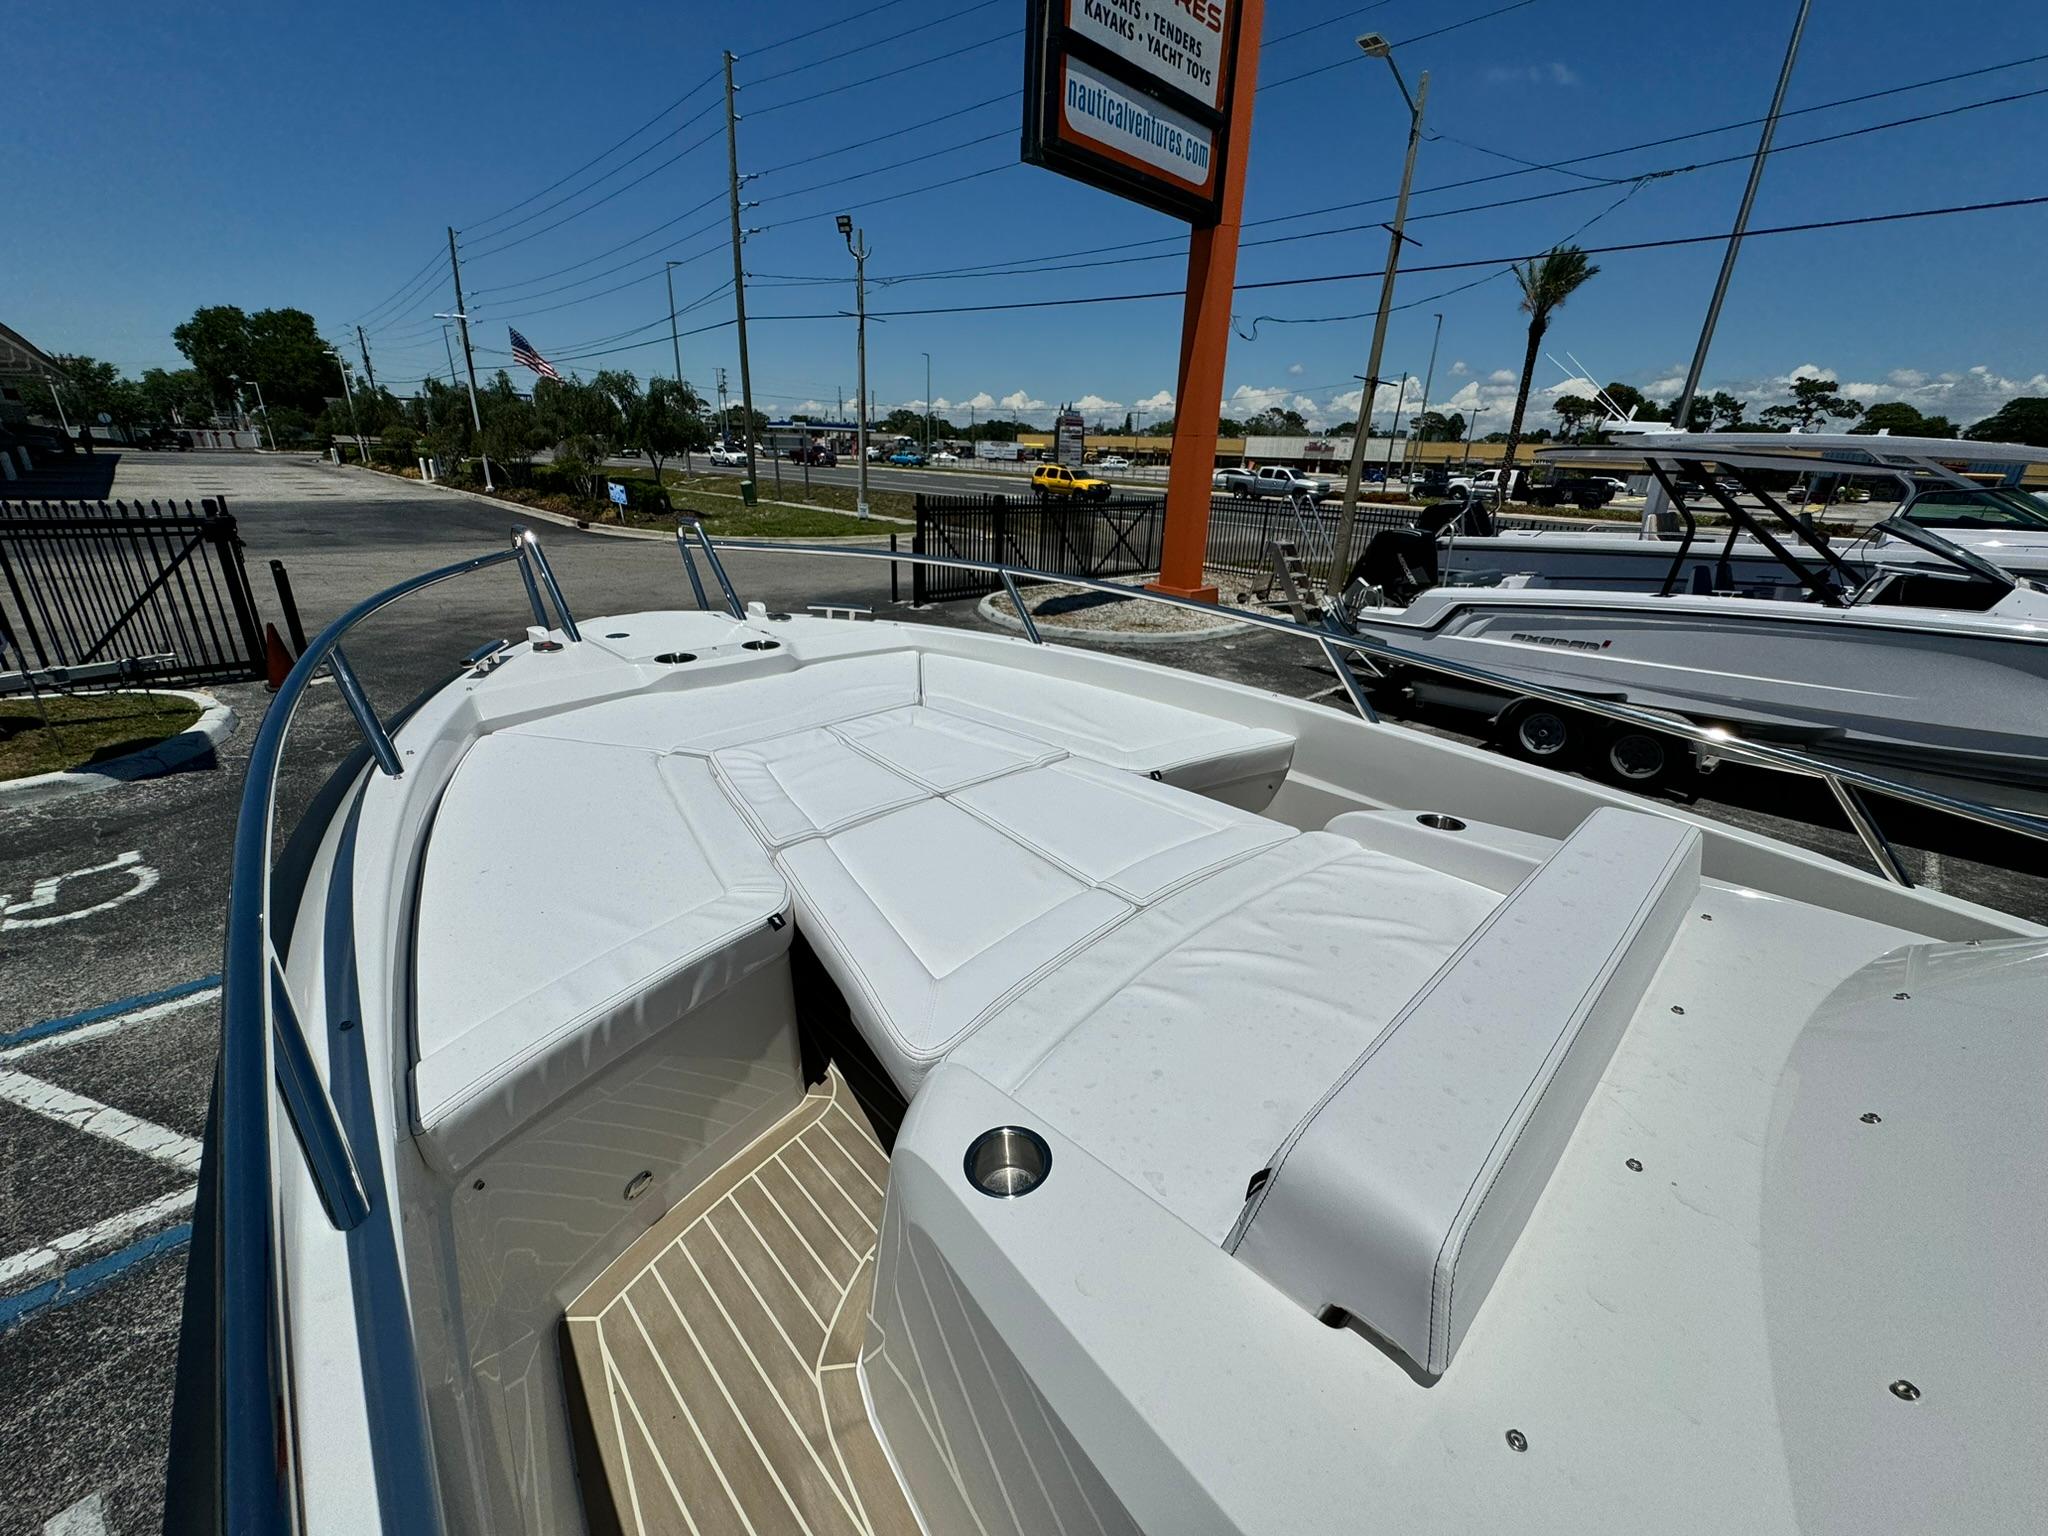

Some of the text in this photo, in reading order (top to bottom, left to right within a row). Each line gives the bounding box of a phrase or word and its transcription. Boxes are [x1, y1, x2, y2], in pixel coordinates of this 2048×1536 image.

[1084, 0, 1211, 87] KAYAKS YACHT TOYS
[1153, 12, 1202, 58] TENDERS
[1067, 78, 1209, 170] nauticalventures.com
